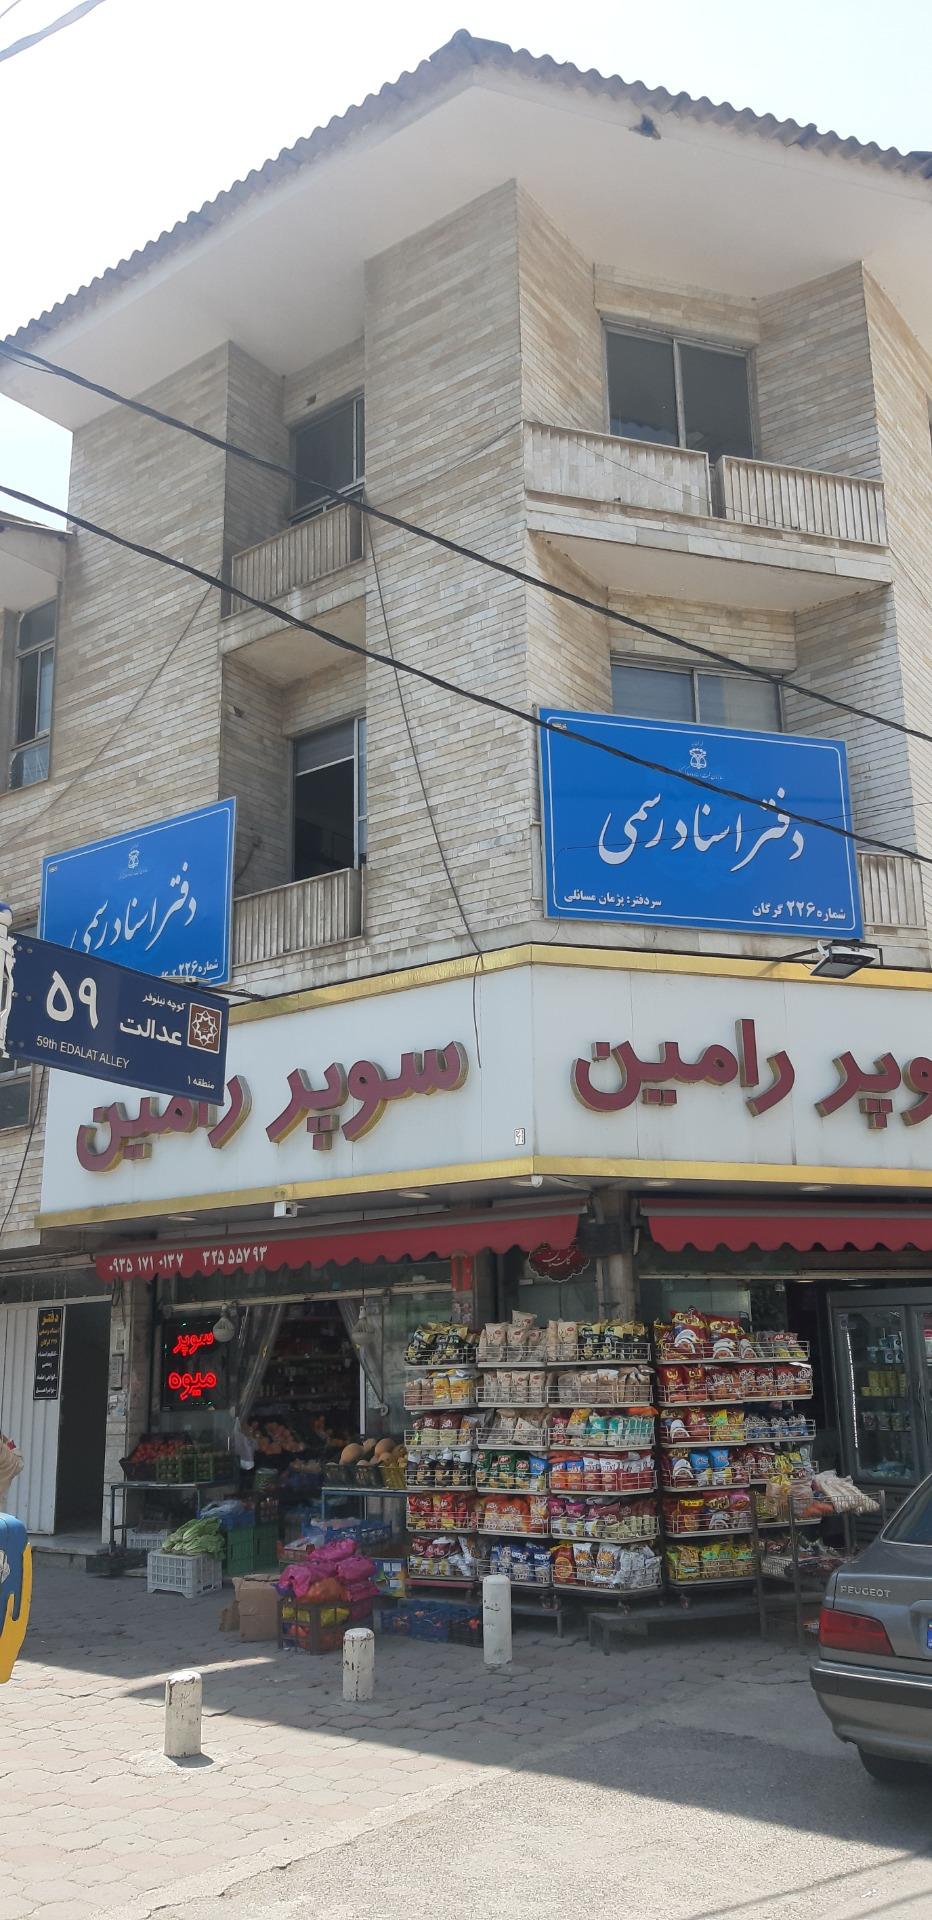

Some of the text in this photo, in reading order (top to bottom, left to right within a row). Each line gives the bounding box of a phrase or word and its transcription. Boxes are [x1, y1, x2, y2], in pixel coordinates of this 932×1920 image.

[598, 787, 805, 873] دفتر اسناد رسمی
[145, 861, 197, 951] دفتر
[599, 891, 624, 906] پژمان
[752, 900, 846, 922] شماره ۲۲۶ گرگان
[110, 897, 157, 943] اسناد
[198, 959, 219, 977] شماره
[46, 970, 99, 1030] ۵۹
[142, 992, 186, 1013] کوچه نیلوفر
[119, 1018, 182, 1046] عدالت
[36, 1035, 130, 1069] 59th EDALAT ALLEY
[192, 1076, 215, 1090] منطقه
[570, 1018, 932, 1130] وپر رامین
[266, 1040, 469, 1152] سوپر
[172, 1331, 215, 1357] سوپر
[168, 1372, 217, 1401] میوه
[840, 1585, 891, 1598] PEUGEOT
